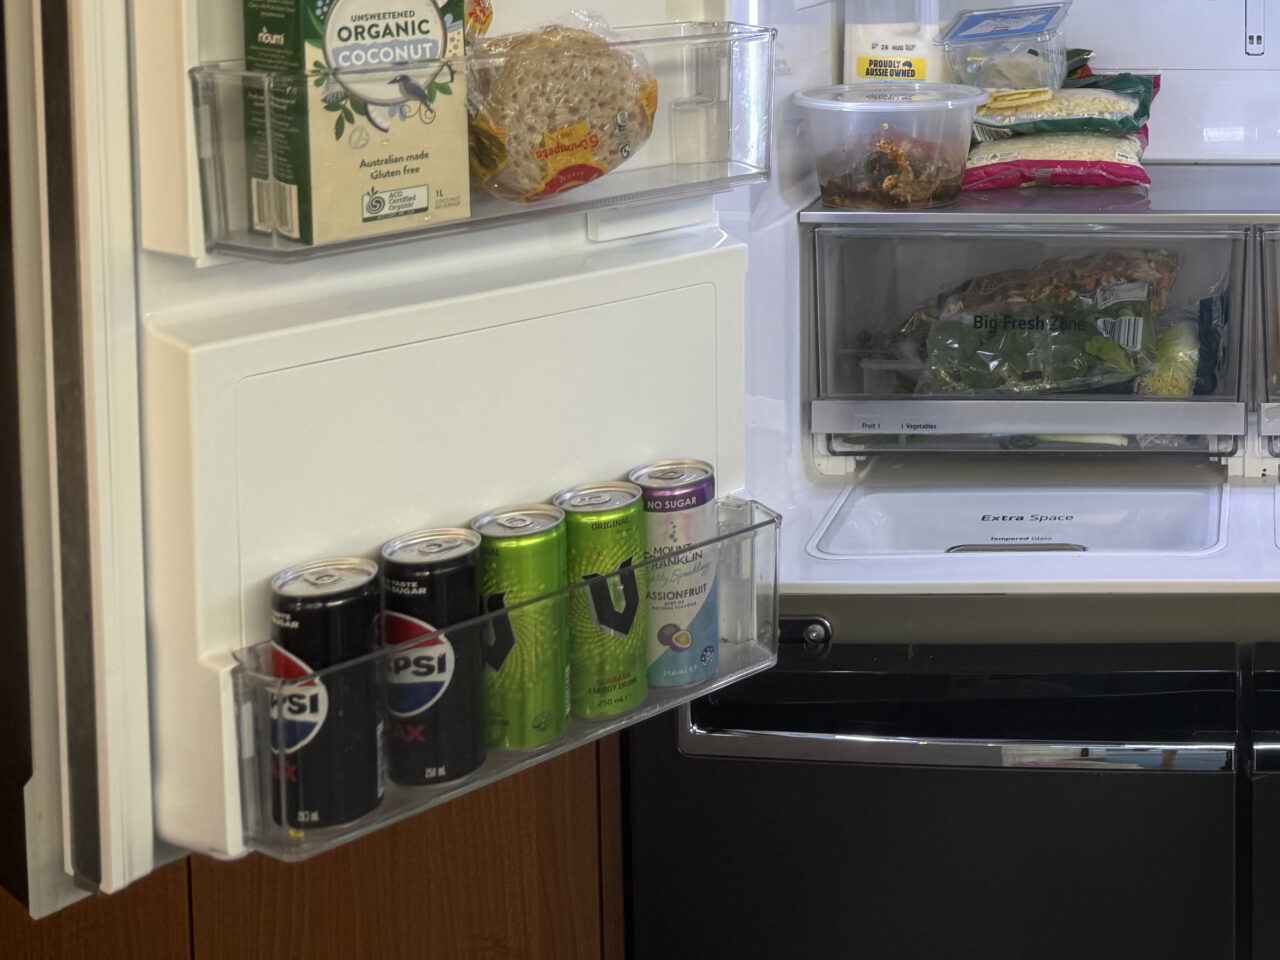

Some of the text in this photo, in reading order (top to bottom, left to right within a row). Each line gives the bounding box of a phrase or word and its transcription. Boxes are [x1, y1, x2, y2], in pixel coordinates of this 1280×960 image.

[351, 10, 416, 22] UNSWEETENED
[337, 19, 431, 42] ORGANIC
[338, 41, 434, 67] COCONUT
[868, 59, 901, 69] PROUDLY
[865, 67, 916, 78] AUSSIE OWNED
[535, 140, 589, 161] Crumpets
[360, 149, 430, 168] Australian made
[370, 165, 420, 180] Gluten free
[973, 315, 1086, 333] Big Fresh Zone
[647, 496, 697, 511] NO SUGAR
[591, 518, 630, 531] ORIGINAL
[1029, 514, 1075, 522] Space
[653, 543, 692, 556] MOUNT
[391, 587, 427, 596] SUGAR
[581, 555, 640, 638] V
[645, 582, 708, 602] ASSIONFRUIT
